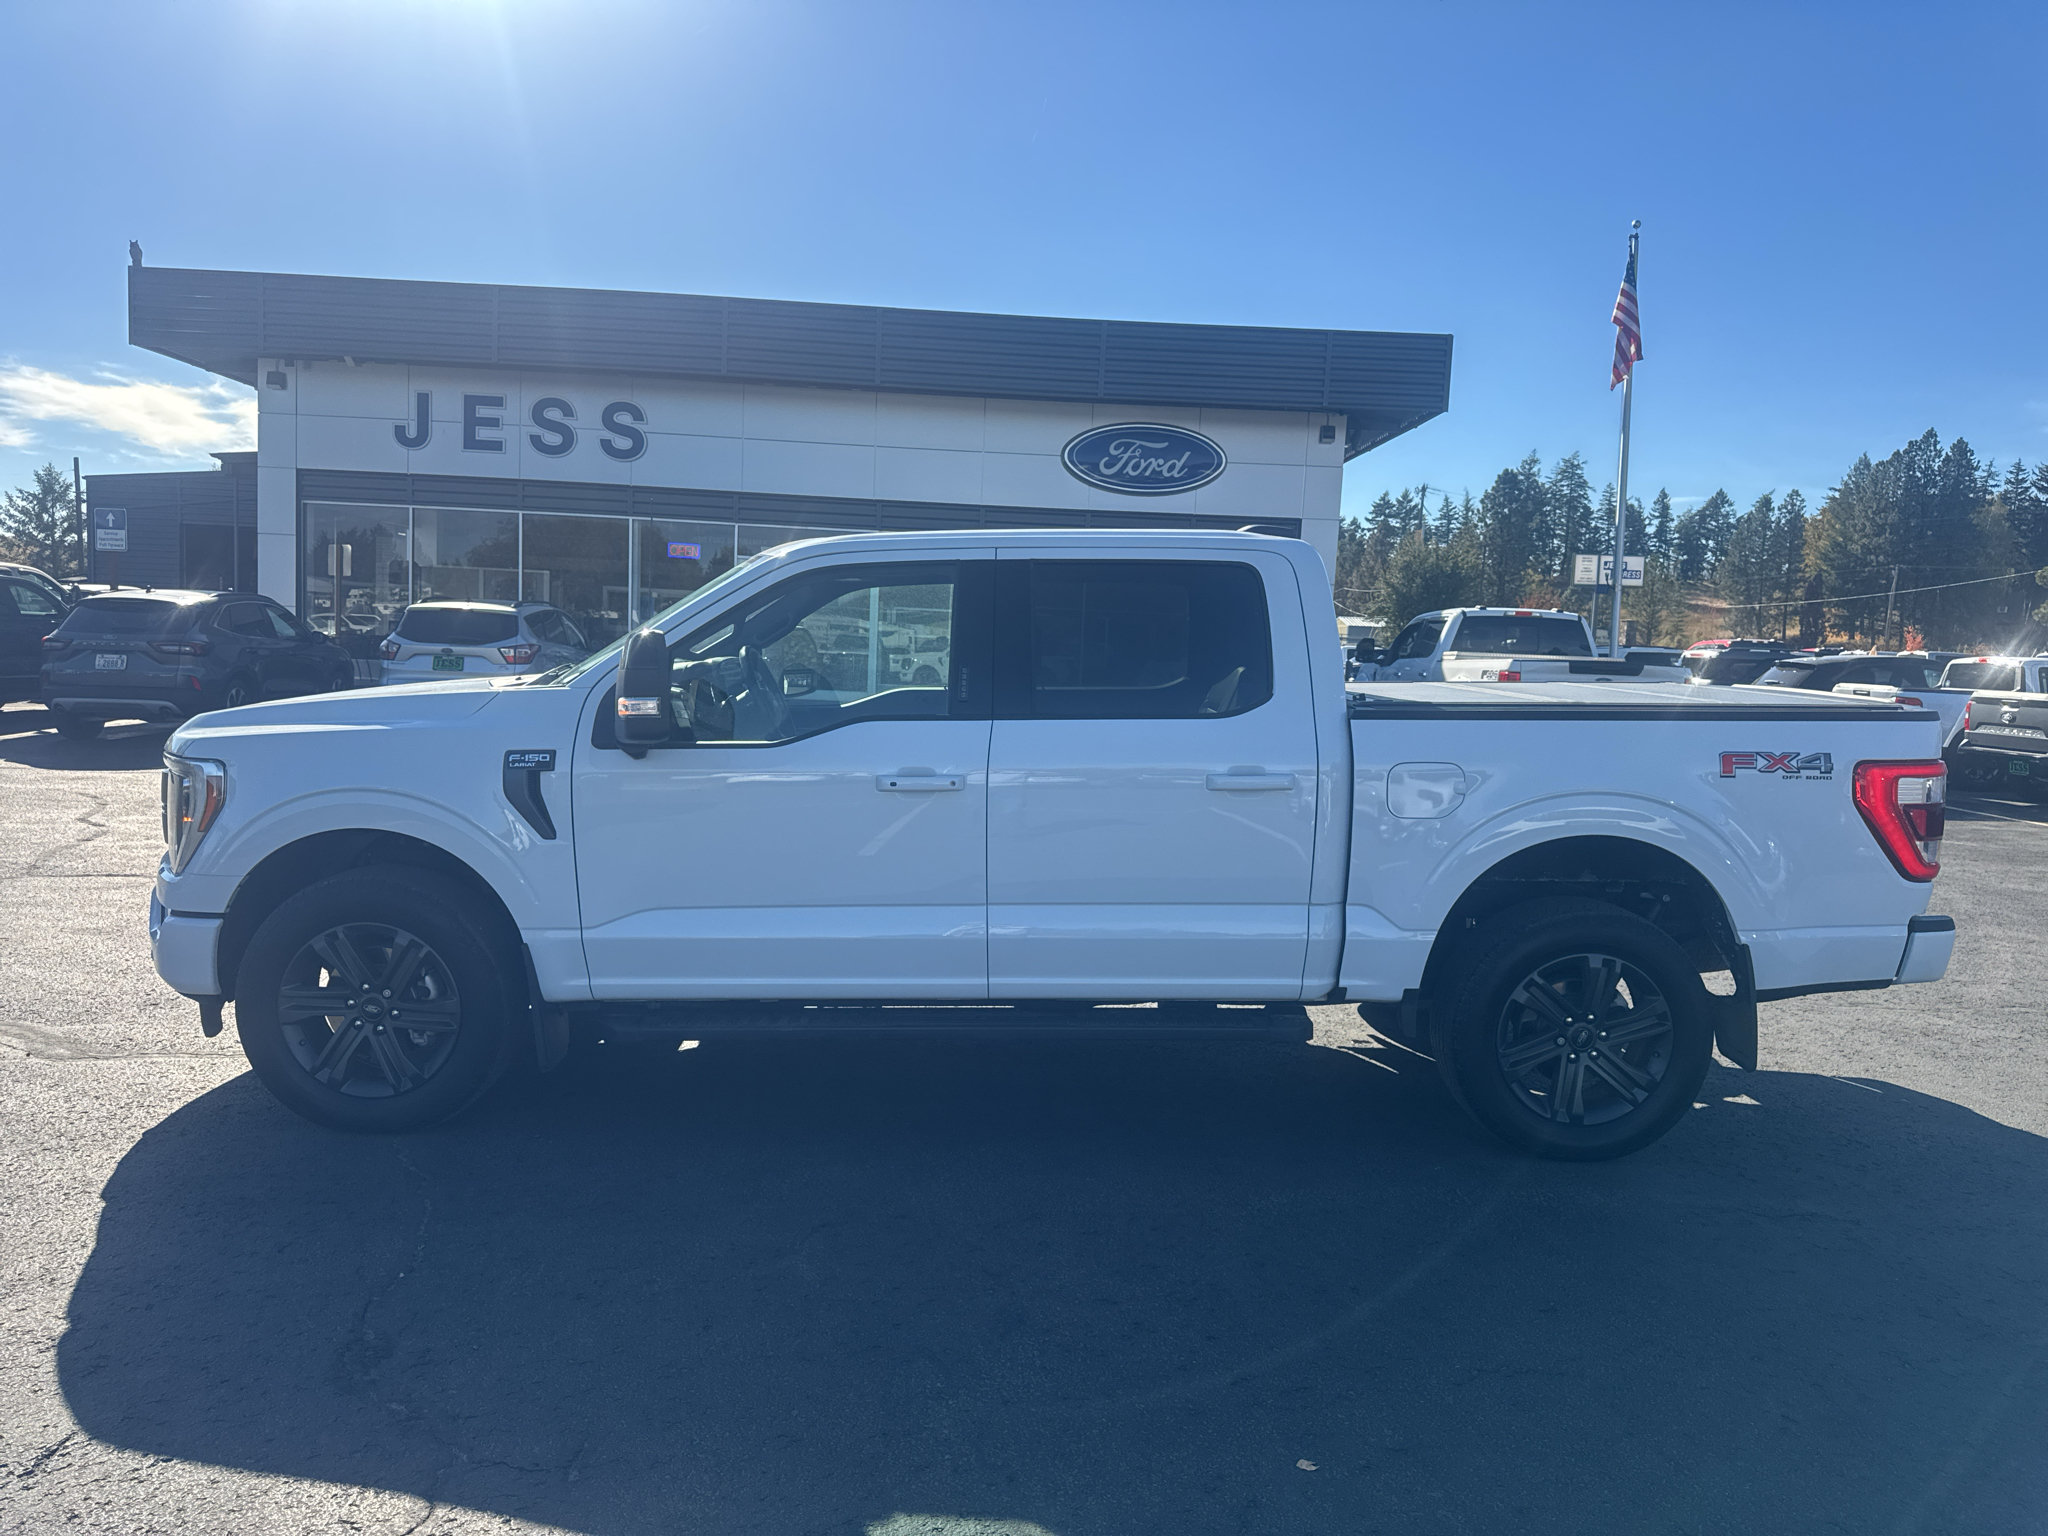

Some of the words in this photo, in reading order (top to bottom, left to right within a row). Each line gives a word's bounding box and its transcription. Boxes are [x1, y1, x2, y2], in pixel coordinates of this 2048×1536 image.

[392, 390, 648, 462] JESS
[1099, 438, 1192, 478] Ford
[670, 544, 699, 557] OPEN
[1603, 561, 1626, 569] JES
[435, 658, 461, 668] JESS
[509, 754, 550, 762] F-150
[1719, 751, 1834, 778] FX4
